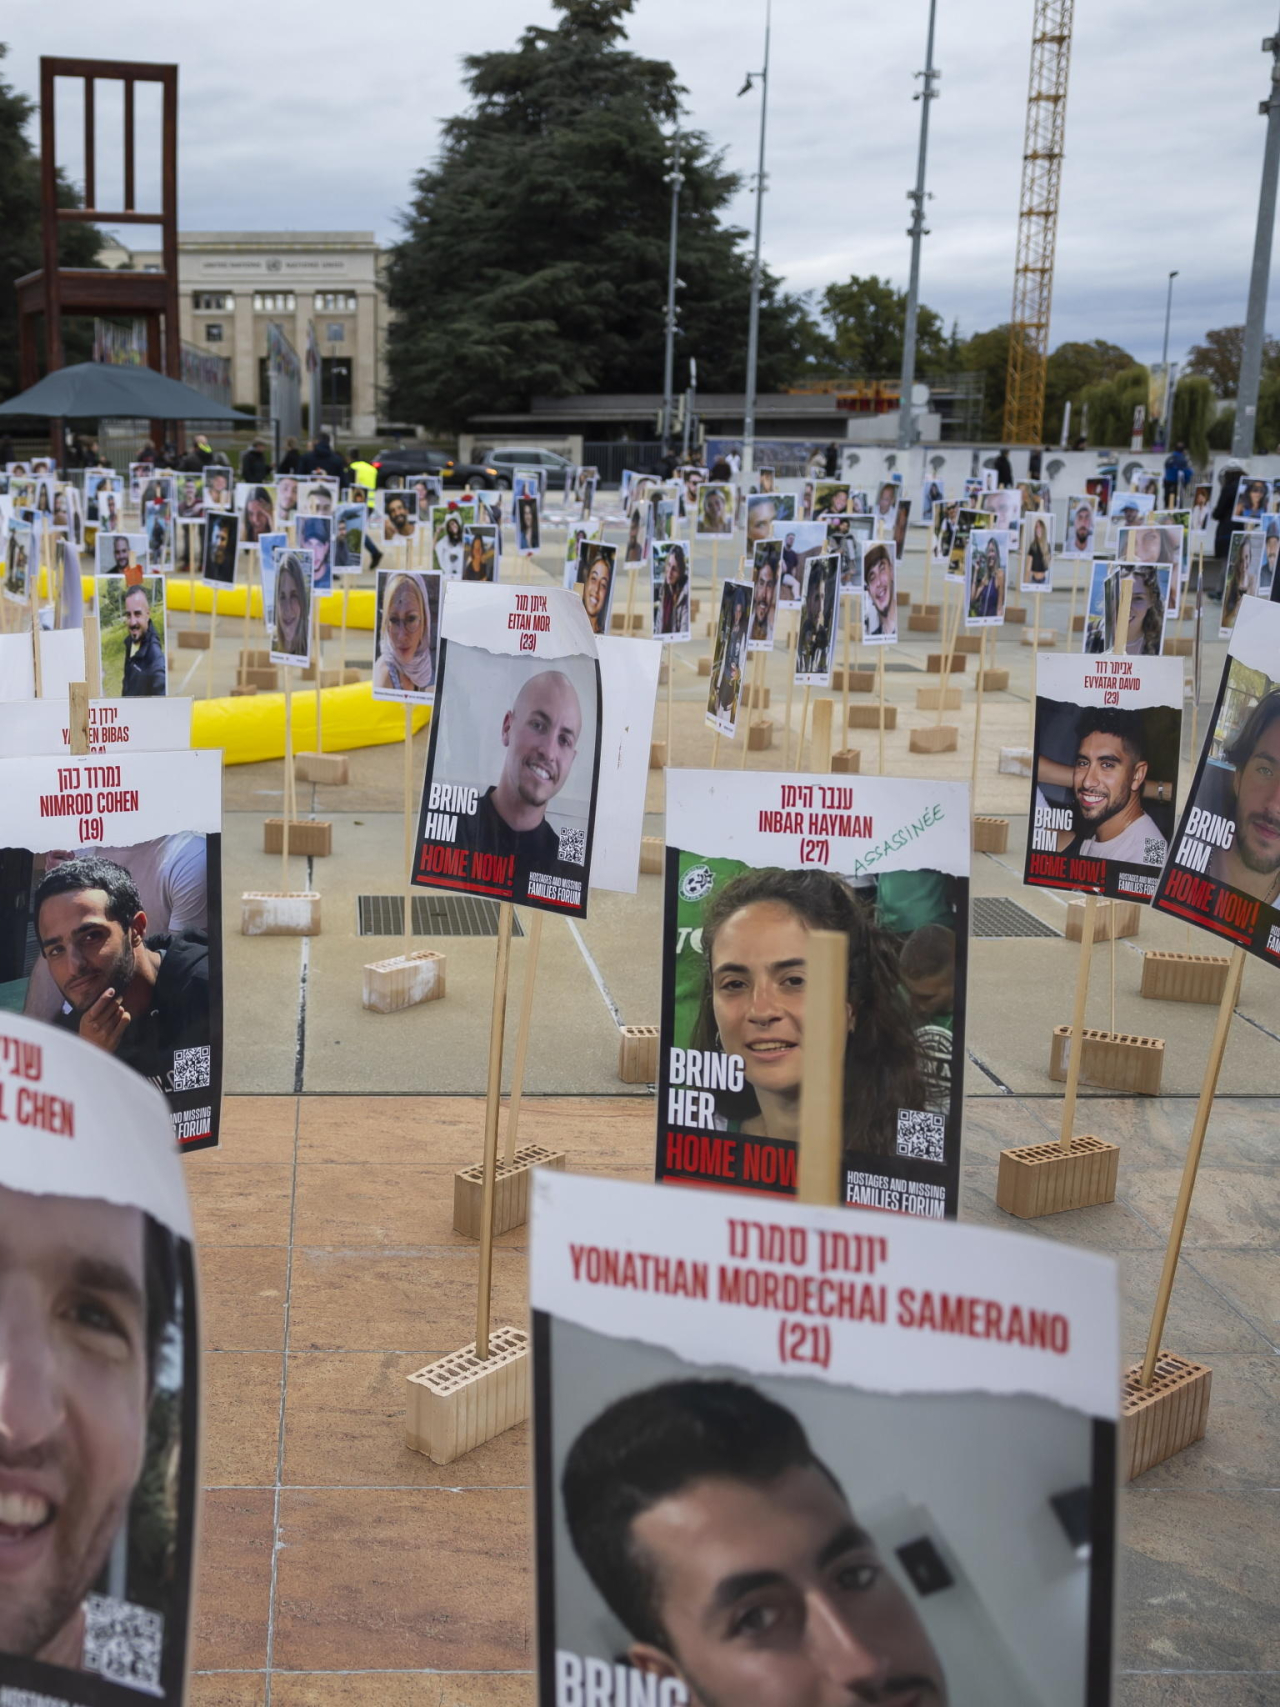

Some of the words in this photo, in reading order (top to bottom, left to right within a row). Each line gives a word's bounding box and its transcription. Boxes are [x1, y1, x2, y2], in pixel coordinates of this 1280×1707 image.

[516, 594, 528, 611] מור
[529, 595, 548, 613] איתן
[508, 613, 531, 631] EITAN
[533, 616, 551, 633] MOR
[519, 632, 537, 652] (23)
[1095, 661, 1108, 673] דוד
[1109, 661, 1133, 675] אביתר
[1084, 676, 1117, 690] EVYATAR
[1119, 678, 1140, 691] DAVID
[1103, 691, 1119, 705] (23)
[99, 708, 117, 726] ירדן
[101, 726, 129, 743] BIBAS
[57, 767, 80, 793] כהן
[84, 765, 121, 789] נמרוד
[39, 793, 93, 817] NIMROD
[97, 790, 139, 813] COHEN
[429, 782, 480, 816] BRING
[781, 784, 813, 810] הימן
[818, 786, 853, 811] ענבר
[79, 817, 104, 843] (19)
[424, 812, 458, 843] HIM
[759, 810, 804, 834] INBAR
[808, 813, 873, 839] HAYMAN
[1034, 806, 1073, 831] BRING
[1185, 807, 1236, 850] BRING
[800, 838, 830, 865] (27)
[853, 802, 946, 879] ASSASSINÉE
[1032, 829, 1058, 853] HIM
[420, 844, 468, 877] HOME
[471, 850, 515, 886] NOW!
[1175, 836, 1213, 873] HIM
[1029, 853, 1067, 878] HOME
[1069, 859, 1106, 884] NOW!
[528, 880, 557, 900] FAMILIES
[557, 887, 581, 906] FORUM
[1118, 879, 1144, 894] FAMILIES
[1164, 869, 1217, 913] HOME
[1214, 891, 1261, 934] NOW!
[669, 1046, 744, 1092] BRING
[15, 1086, 76, 1139] CHEN
[183, 1106, 212, 1123] MISSING
[667, 1087, 716, 1130] HER
[178, 1117, 211, 1139] FORUM
[666, 1132, 736, 1179] HOME
[742, 1142, 799, 1188] NOW
[847, 1170, 889, 1191] HOSTAGES
[890, 1177, 907, 1193] AND
[908, 1180, 946, 1200] MISSING
[846, 1183, 899, 1211] FAMILIES
[901, 1194, 945, 1220] FORUM
[818, 1229, 888, 1276] יונתן
[569, 1243, 709, 1301] YONATHAN
[717, 1264, 887, 1325] MORDECHAI
[896, 1287, 1070, 1355] SAMERANO
[778, 1320, 832, 1368] (21)
